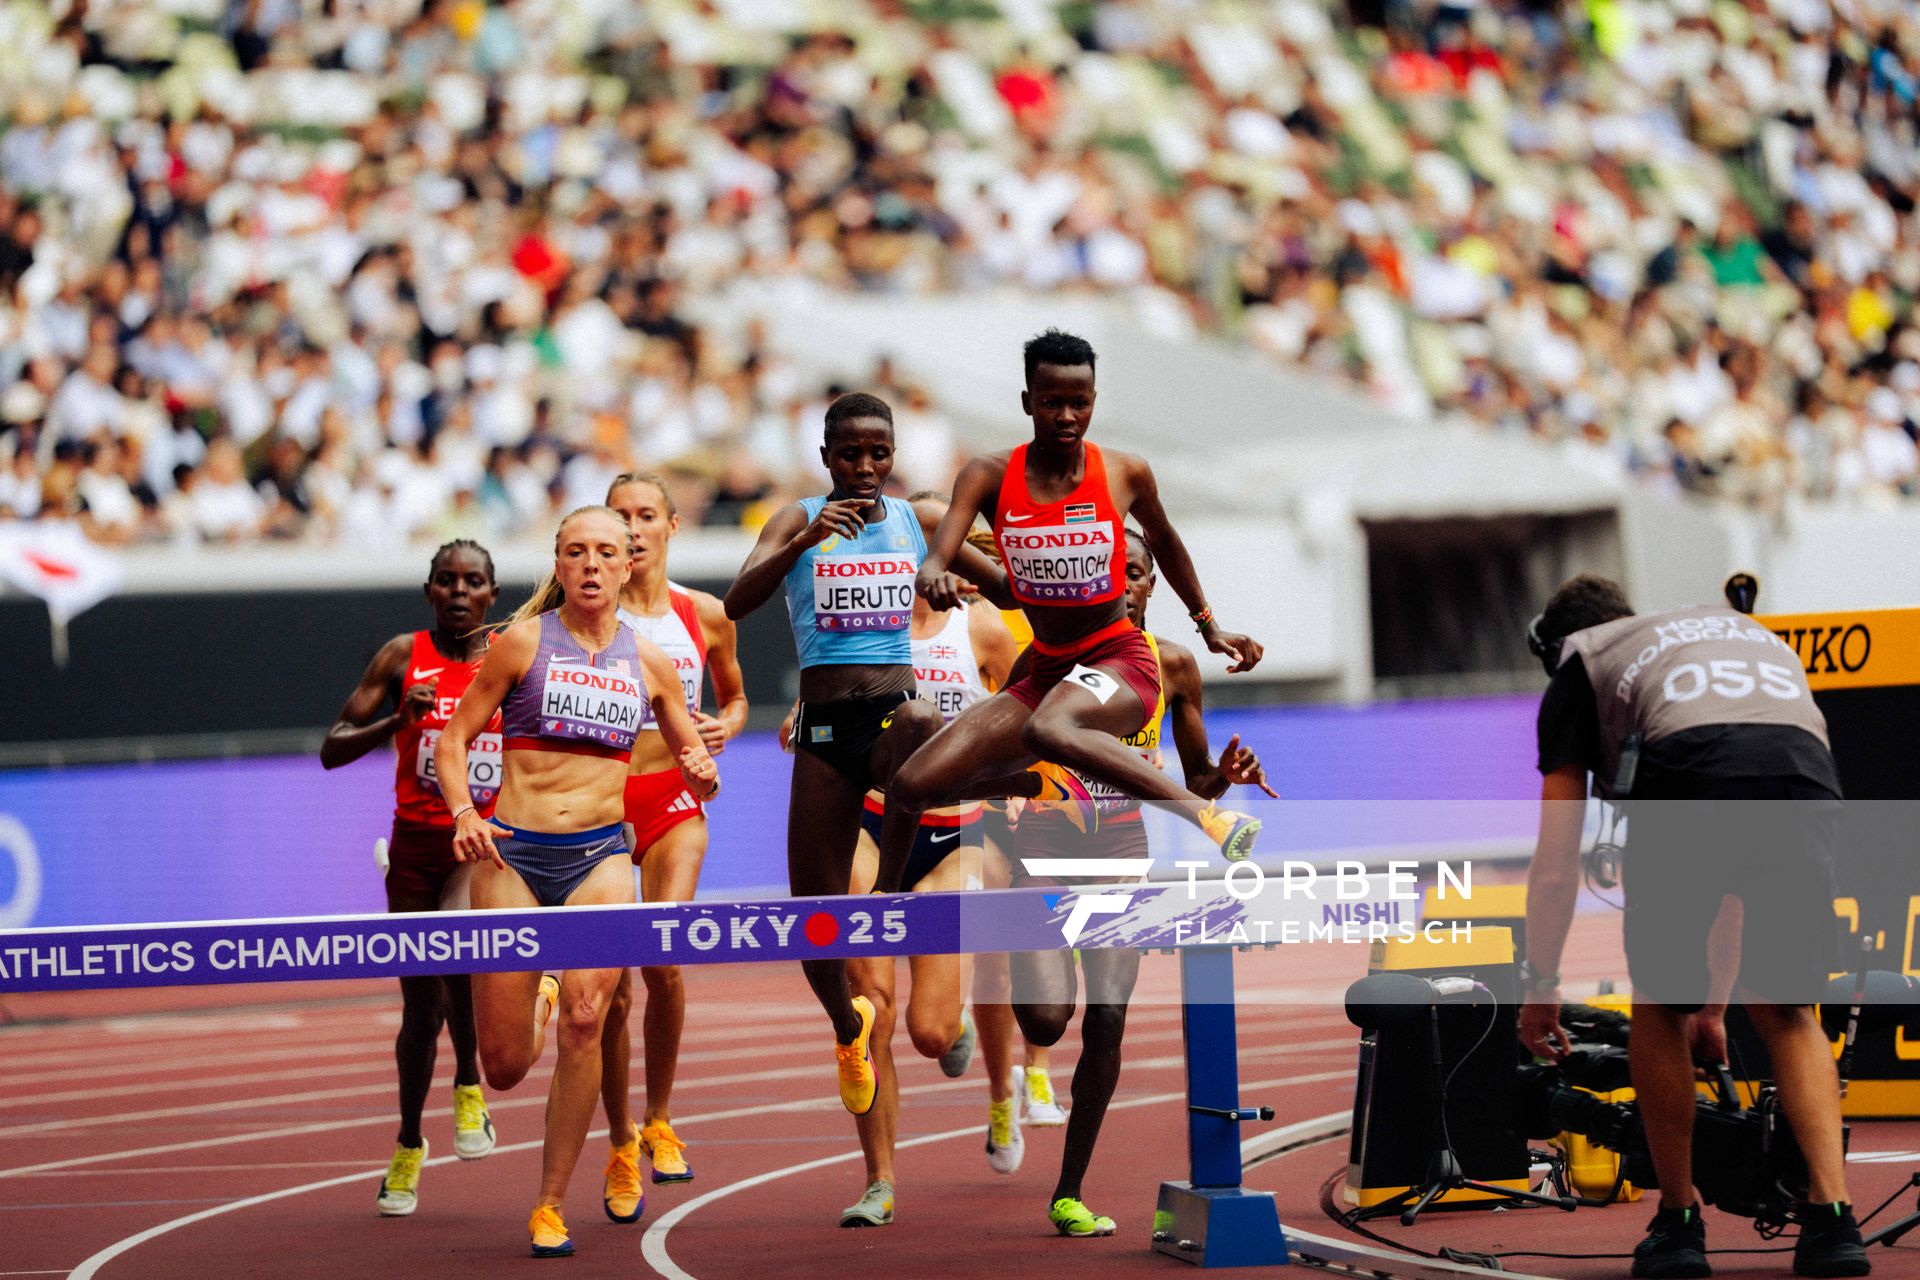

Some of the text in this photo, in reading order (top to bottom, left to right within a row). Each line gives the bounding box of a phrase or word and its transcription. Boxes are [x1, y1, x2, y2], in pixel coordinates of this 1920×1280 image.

[1003, 530, 1111, 549] HONDA
[815, 560, 916, 577] HONDA
[1010, 553, 1109, 580] CHEROTICH
[820, 584, 912, 610] JERUTO
[1653, 615, 1740, 637] HOST
[913, 667, 966, 684] NDA
[1615, 627, 1794, 704] BROADCAST
[548, 669, 639, 698] HONDA
[1078, 672, 1104, 688] 6
[1662, 659, 1801, 703] 055
[546, 691, 638, 729] HALLADAY
[1322, 901, 1401, 926] NISHI
[208, 926, 541, 971] CHAMPIONSHIPS
